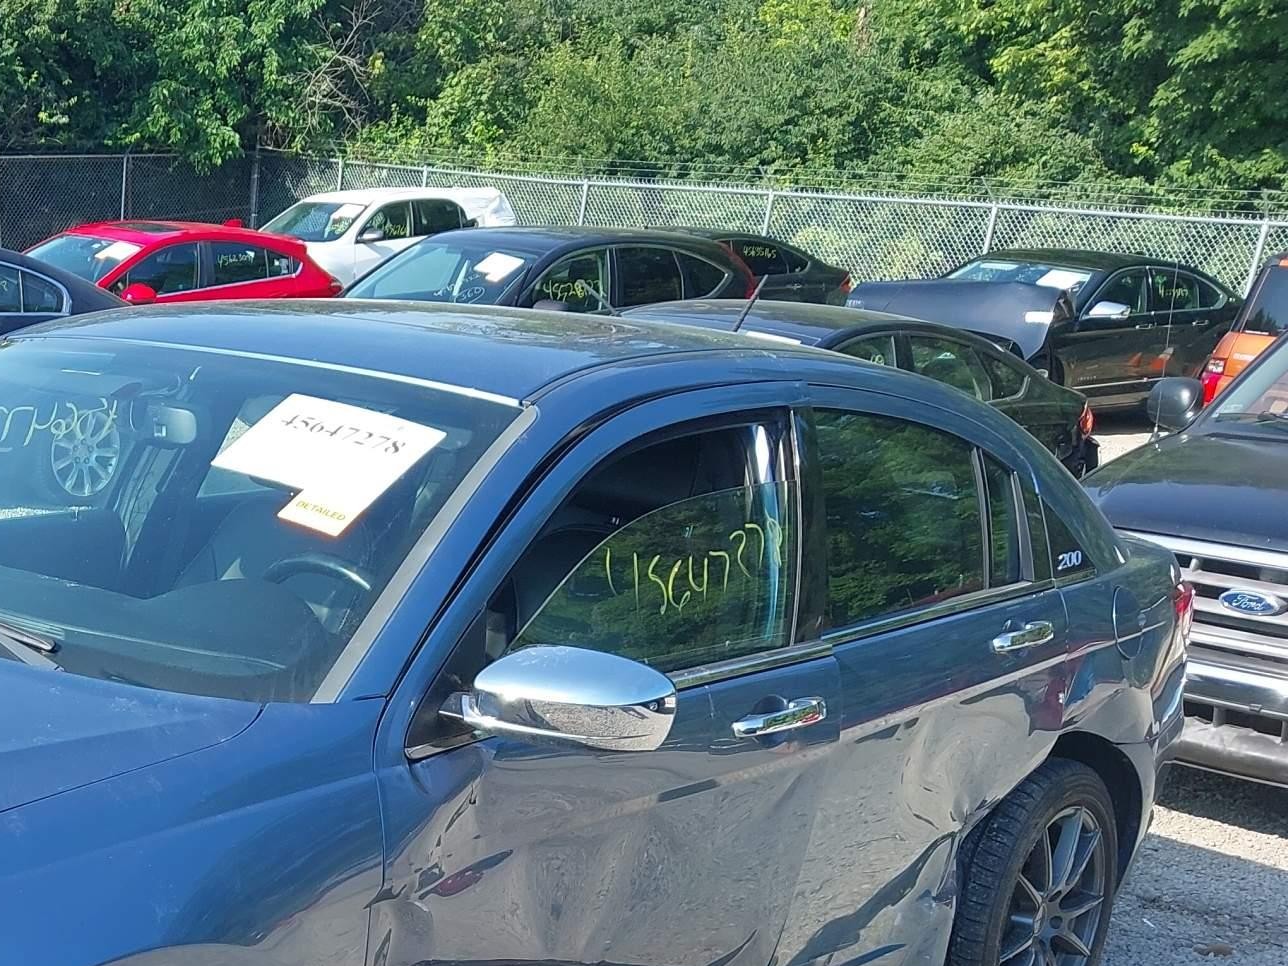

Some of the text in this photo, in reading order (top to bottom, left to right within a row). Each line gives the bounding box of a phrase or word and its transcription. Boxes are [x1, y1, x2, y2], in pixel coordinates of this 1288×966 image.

[281, 414, 406, 454] 45647278
[295, 499, 347, 522] DETAILED
[1057, 550, 1082, 570] 200
